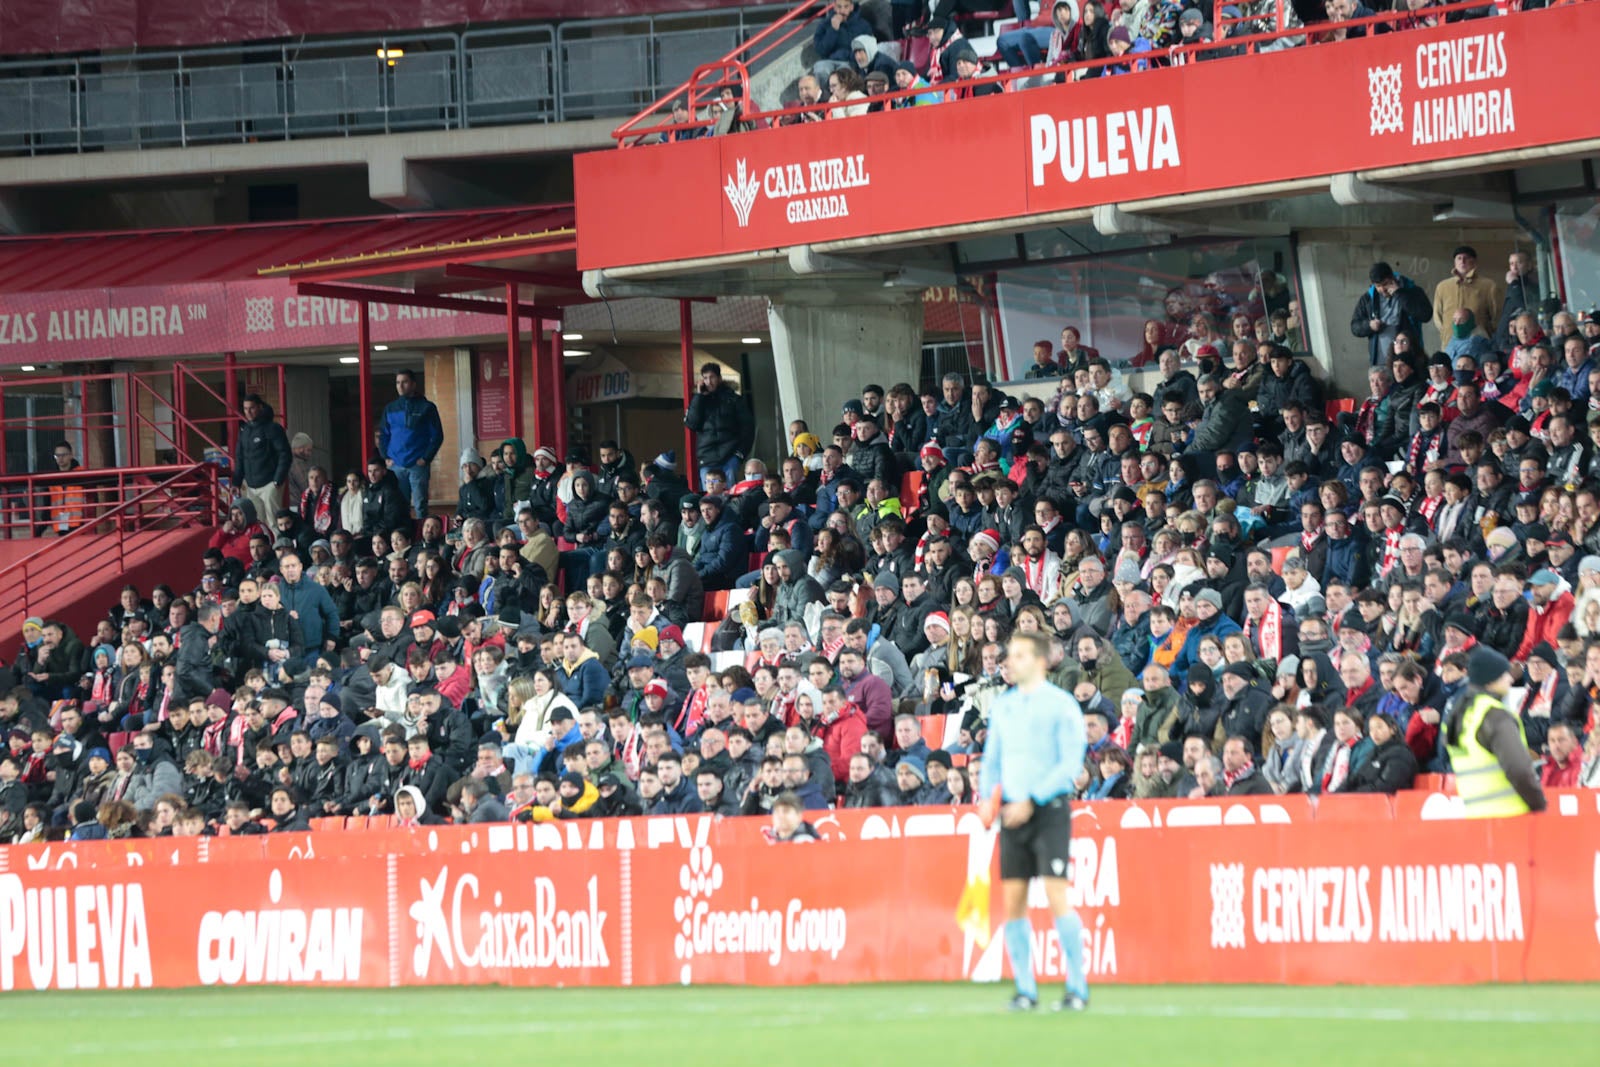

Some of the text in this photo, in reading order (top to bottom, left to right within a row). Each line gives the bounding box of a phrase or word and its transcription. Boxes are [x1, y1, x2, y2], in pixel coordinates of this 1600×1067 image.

[1416, 31, 1508, 89] CERVEZAS
[1030, 104, 1181, 187] PULEVA
[1411, 87, 1516, 146] ALHAMBRA
[764, 154, 870, 198] CAJA RURAL
[786, 194, 849, 224] GRANADA
[47, 305, 184, 342] ALHAMBRA
[187, 304, 207, 320] SIN
[576, 371, 630, 400] HOT DOG
[0, 873, 153, 990] PULEVA
[452, 873, 610, 968] CaixaBank
[693, 896, 847, 966] Greening Group
[1252, 865, 1374, 944] CERVEZAS
[1378, 862, 1525, 942] ALHAMBRA
